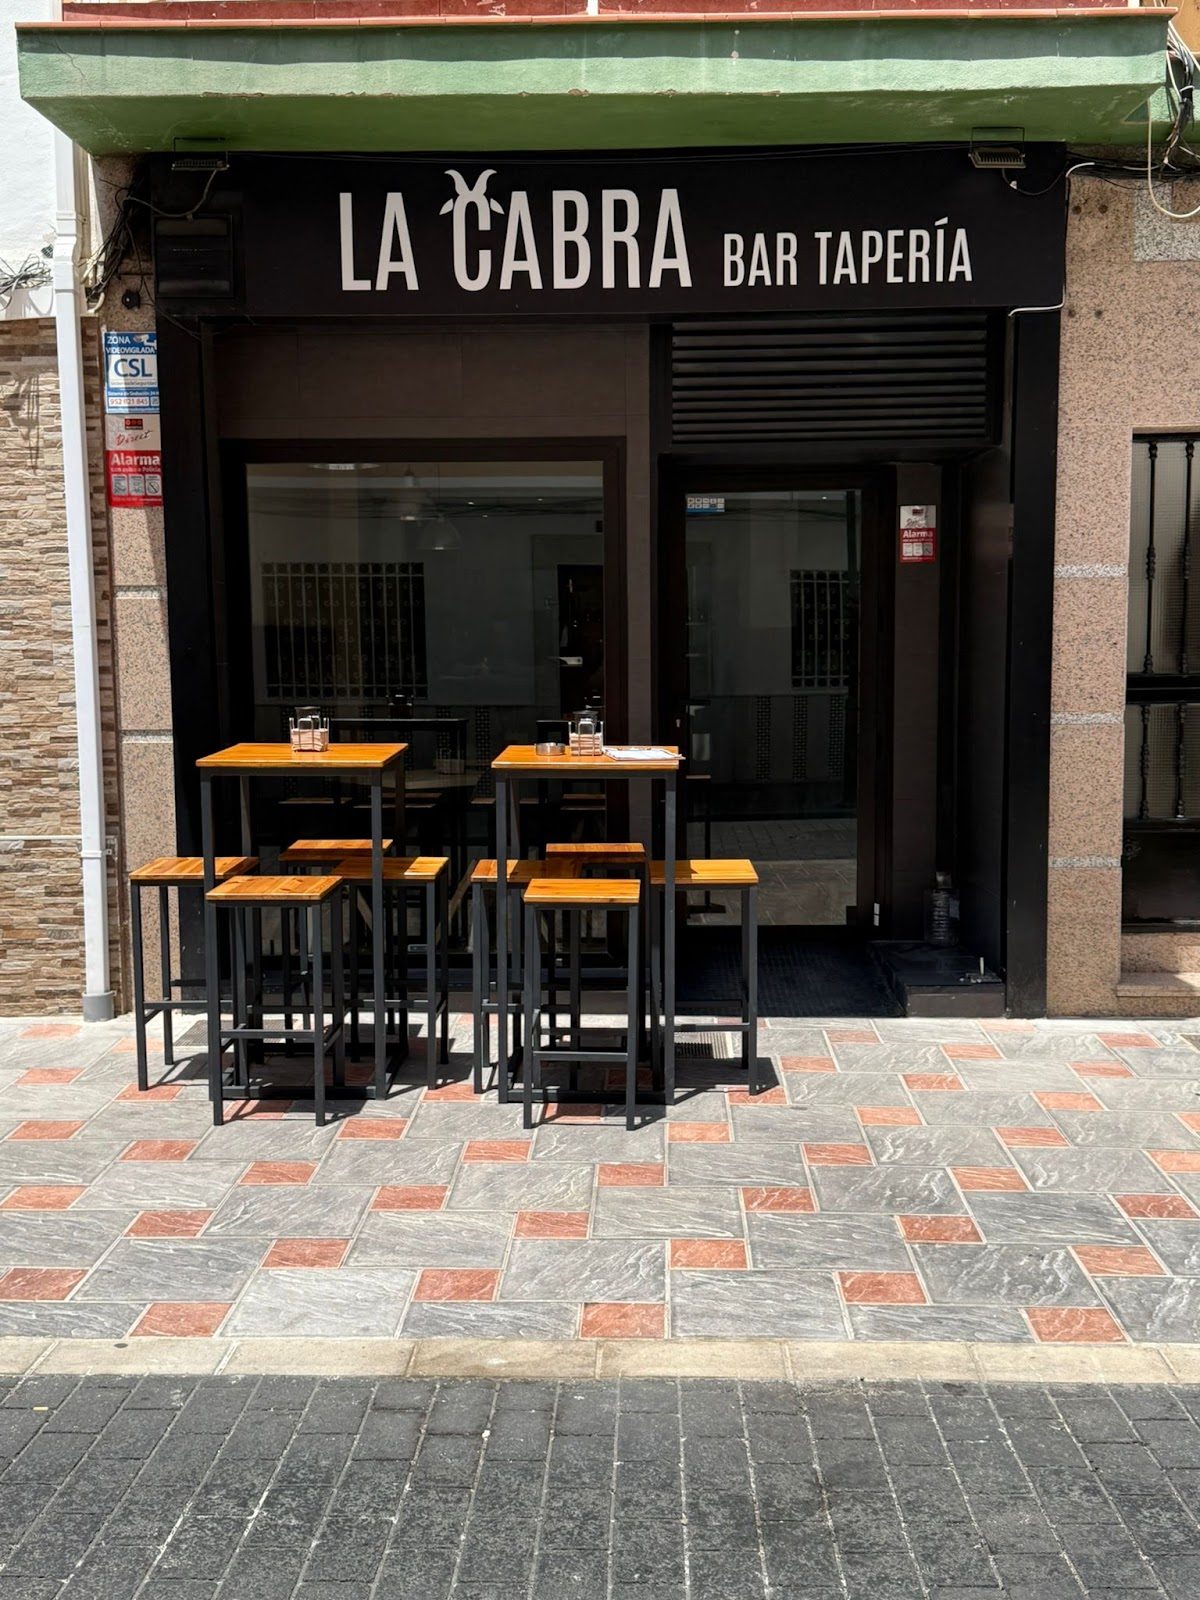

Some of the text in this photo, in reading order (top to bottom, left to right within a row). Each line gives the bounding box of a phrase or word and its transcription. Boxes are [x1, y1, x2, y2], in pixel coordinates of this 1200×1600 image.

[340, 188, 692, 291] LA CABRA
[723, 217, 973, 287] BAR TAPERÍA
[107, 336, 131, 344] ZONA
[114, 359, 153, 377] CSL
[111, 453, 160, 466] Alarma
[903, 530, 933, 538] Alarma
